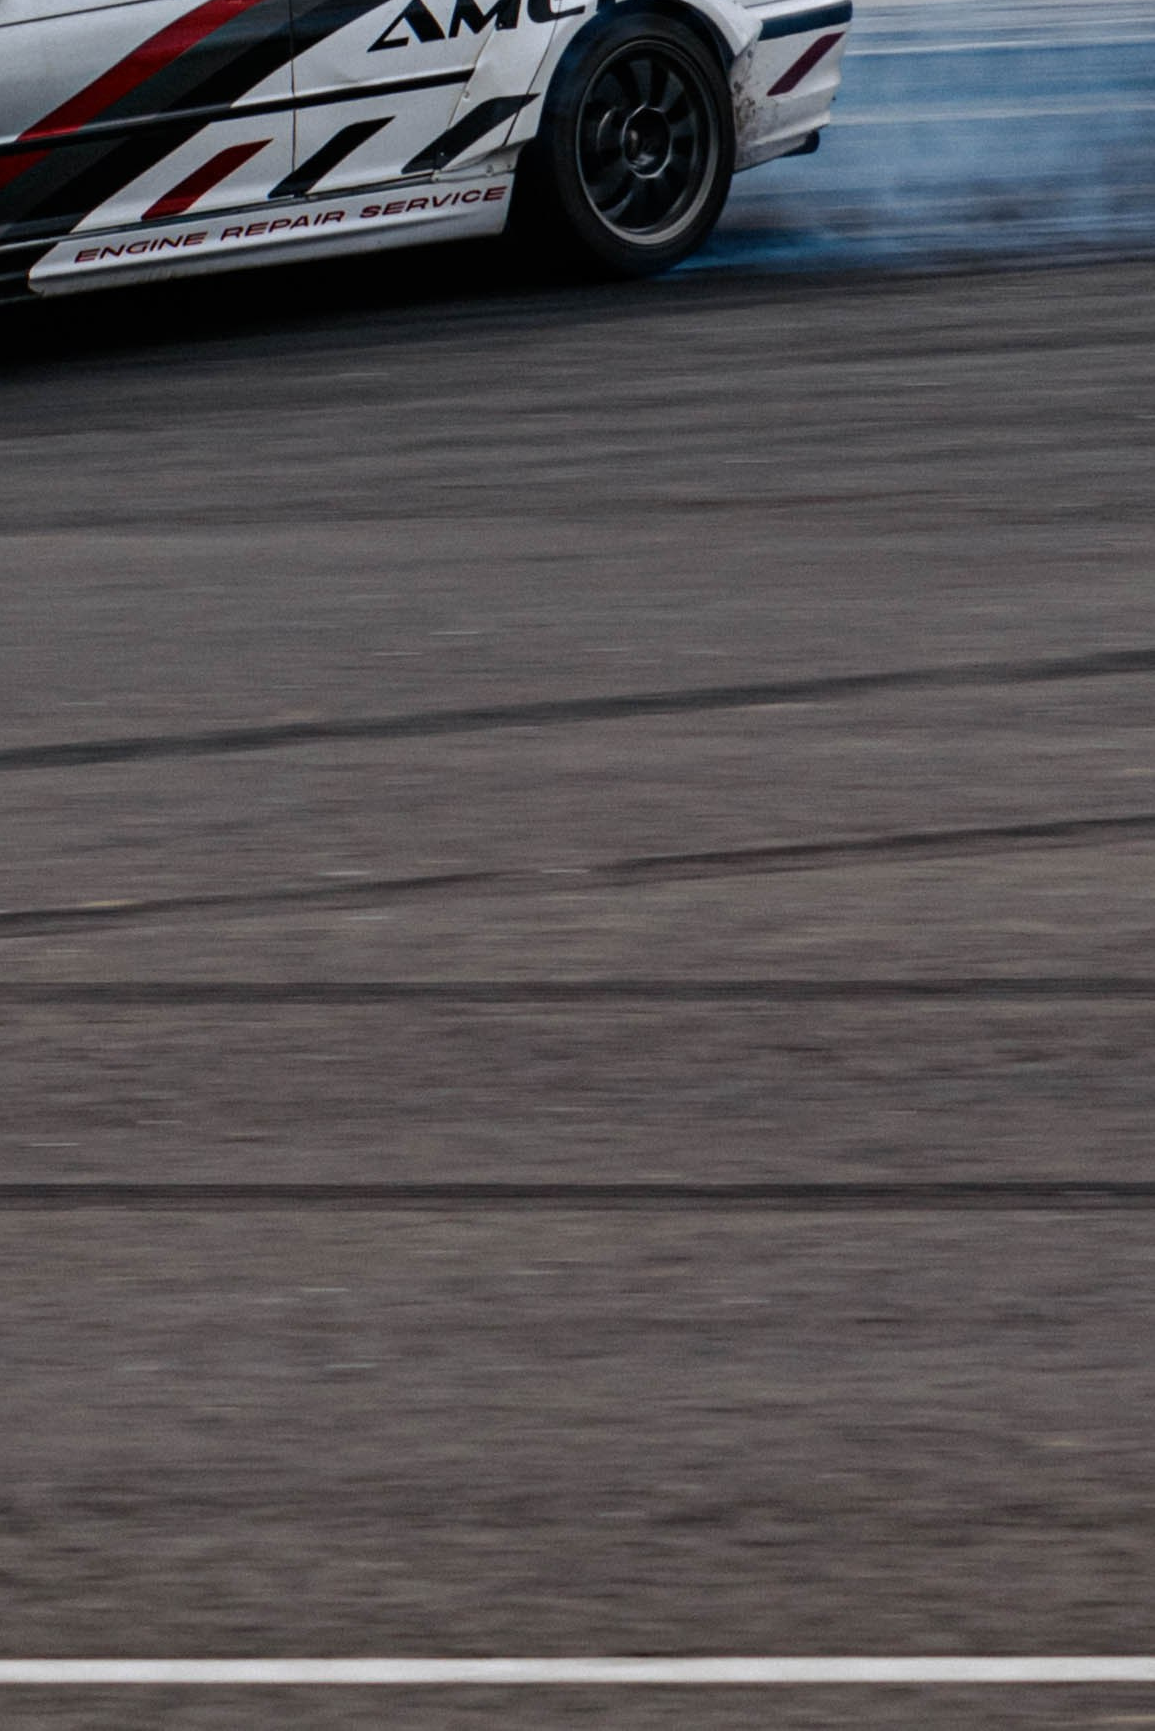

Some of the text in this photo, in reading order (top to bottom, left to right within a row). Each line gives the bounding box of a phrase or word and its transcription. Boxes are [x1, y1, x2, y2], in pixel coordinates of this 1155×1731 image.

[73, 186, 508, 263] ENGINE REPAIR SERVICE
